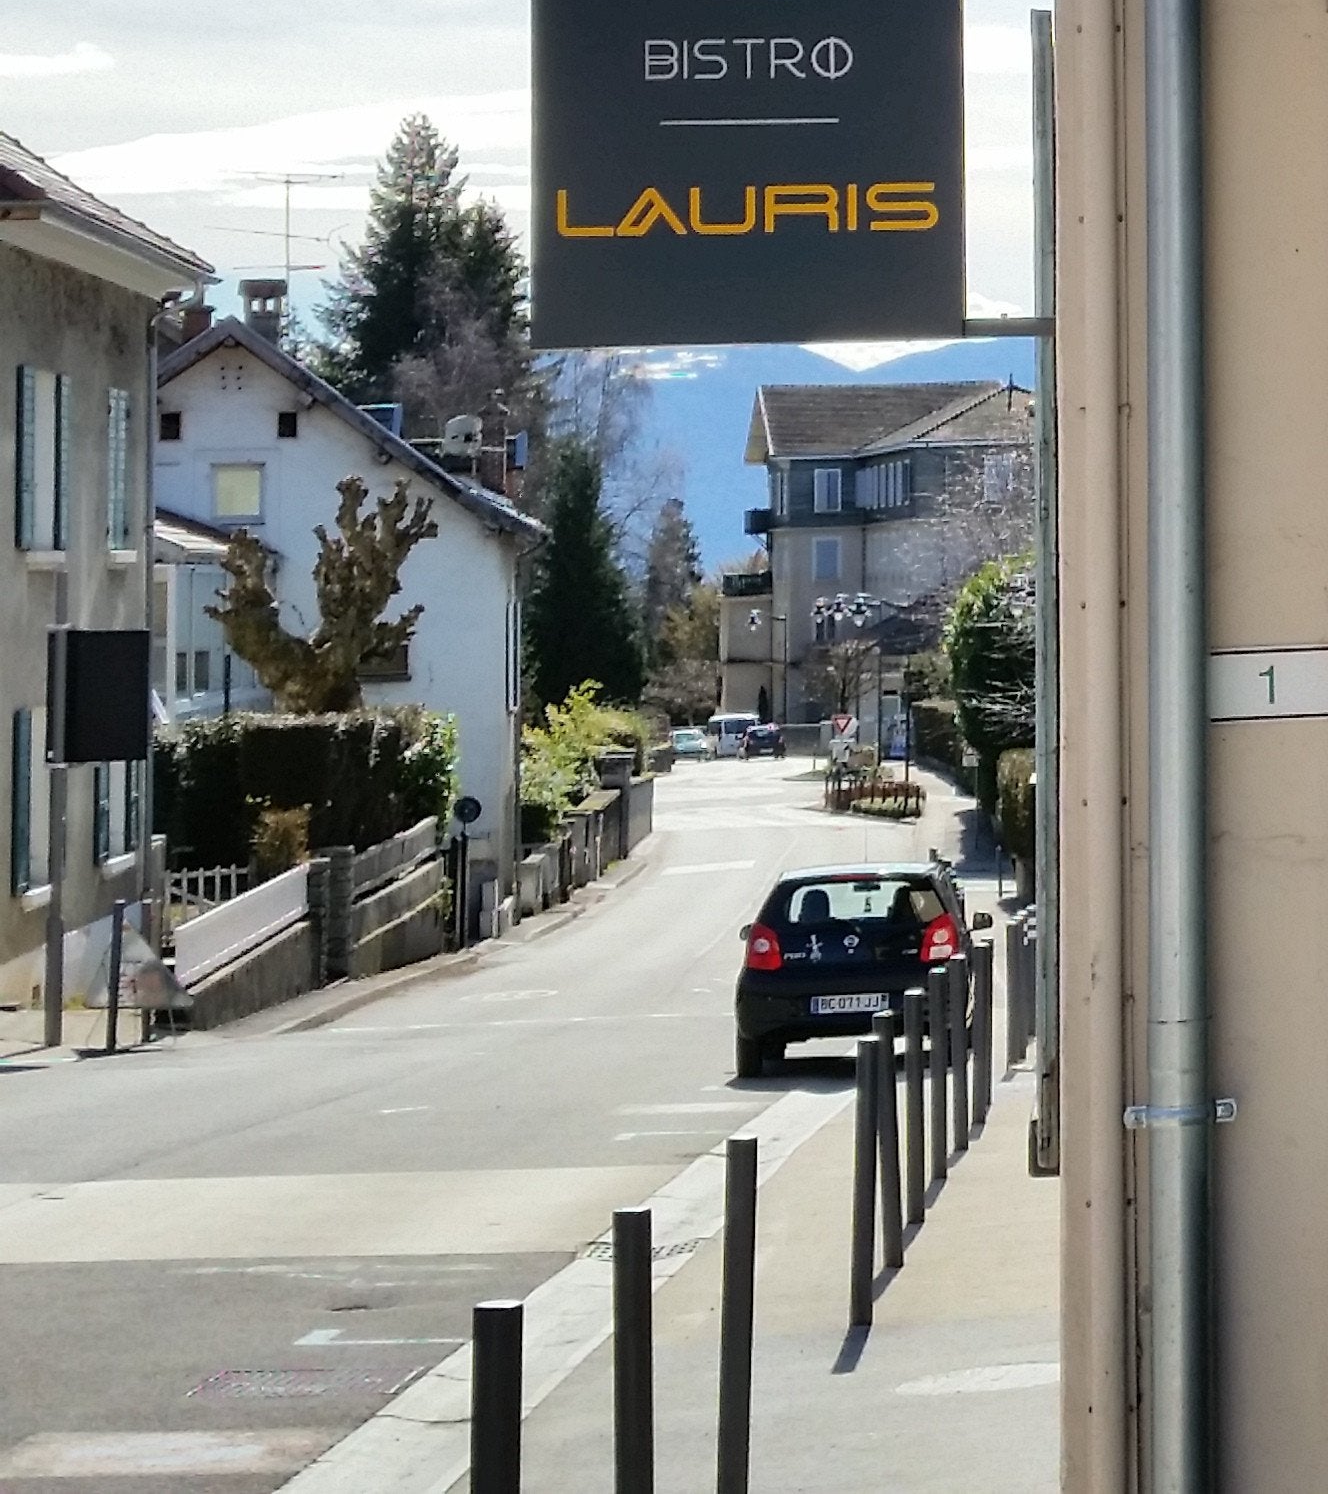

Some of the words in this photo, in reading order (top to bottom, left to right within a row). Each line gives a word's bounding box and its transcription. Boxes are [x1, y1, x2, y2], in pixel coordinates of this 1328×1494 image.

[644, 36, 854, 81] BISTRO
[557, 181, 940, 237] LAURIS
[1259, 665, 1275, 704] 1
